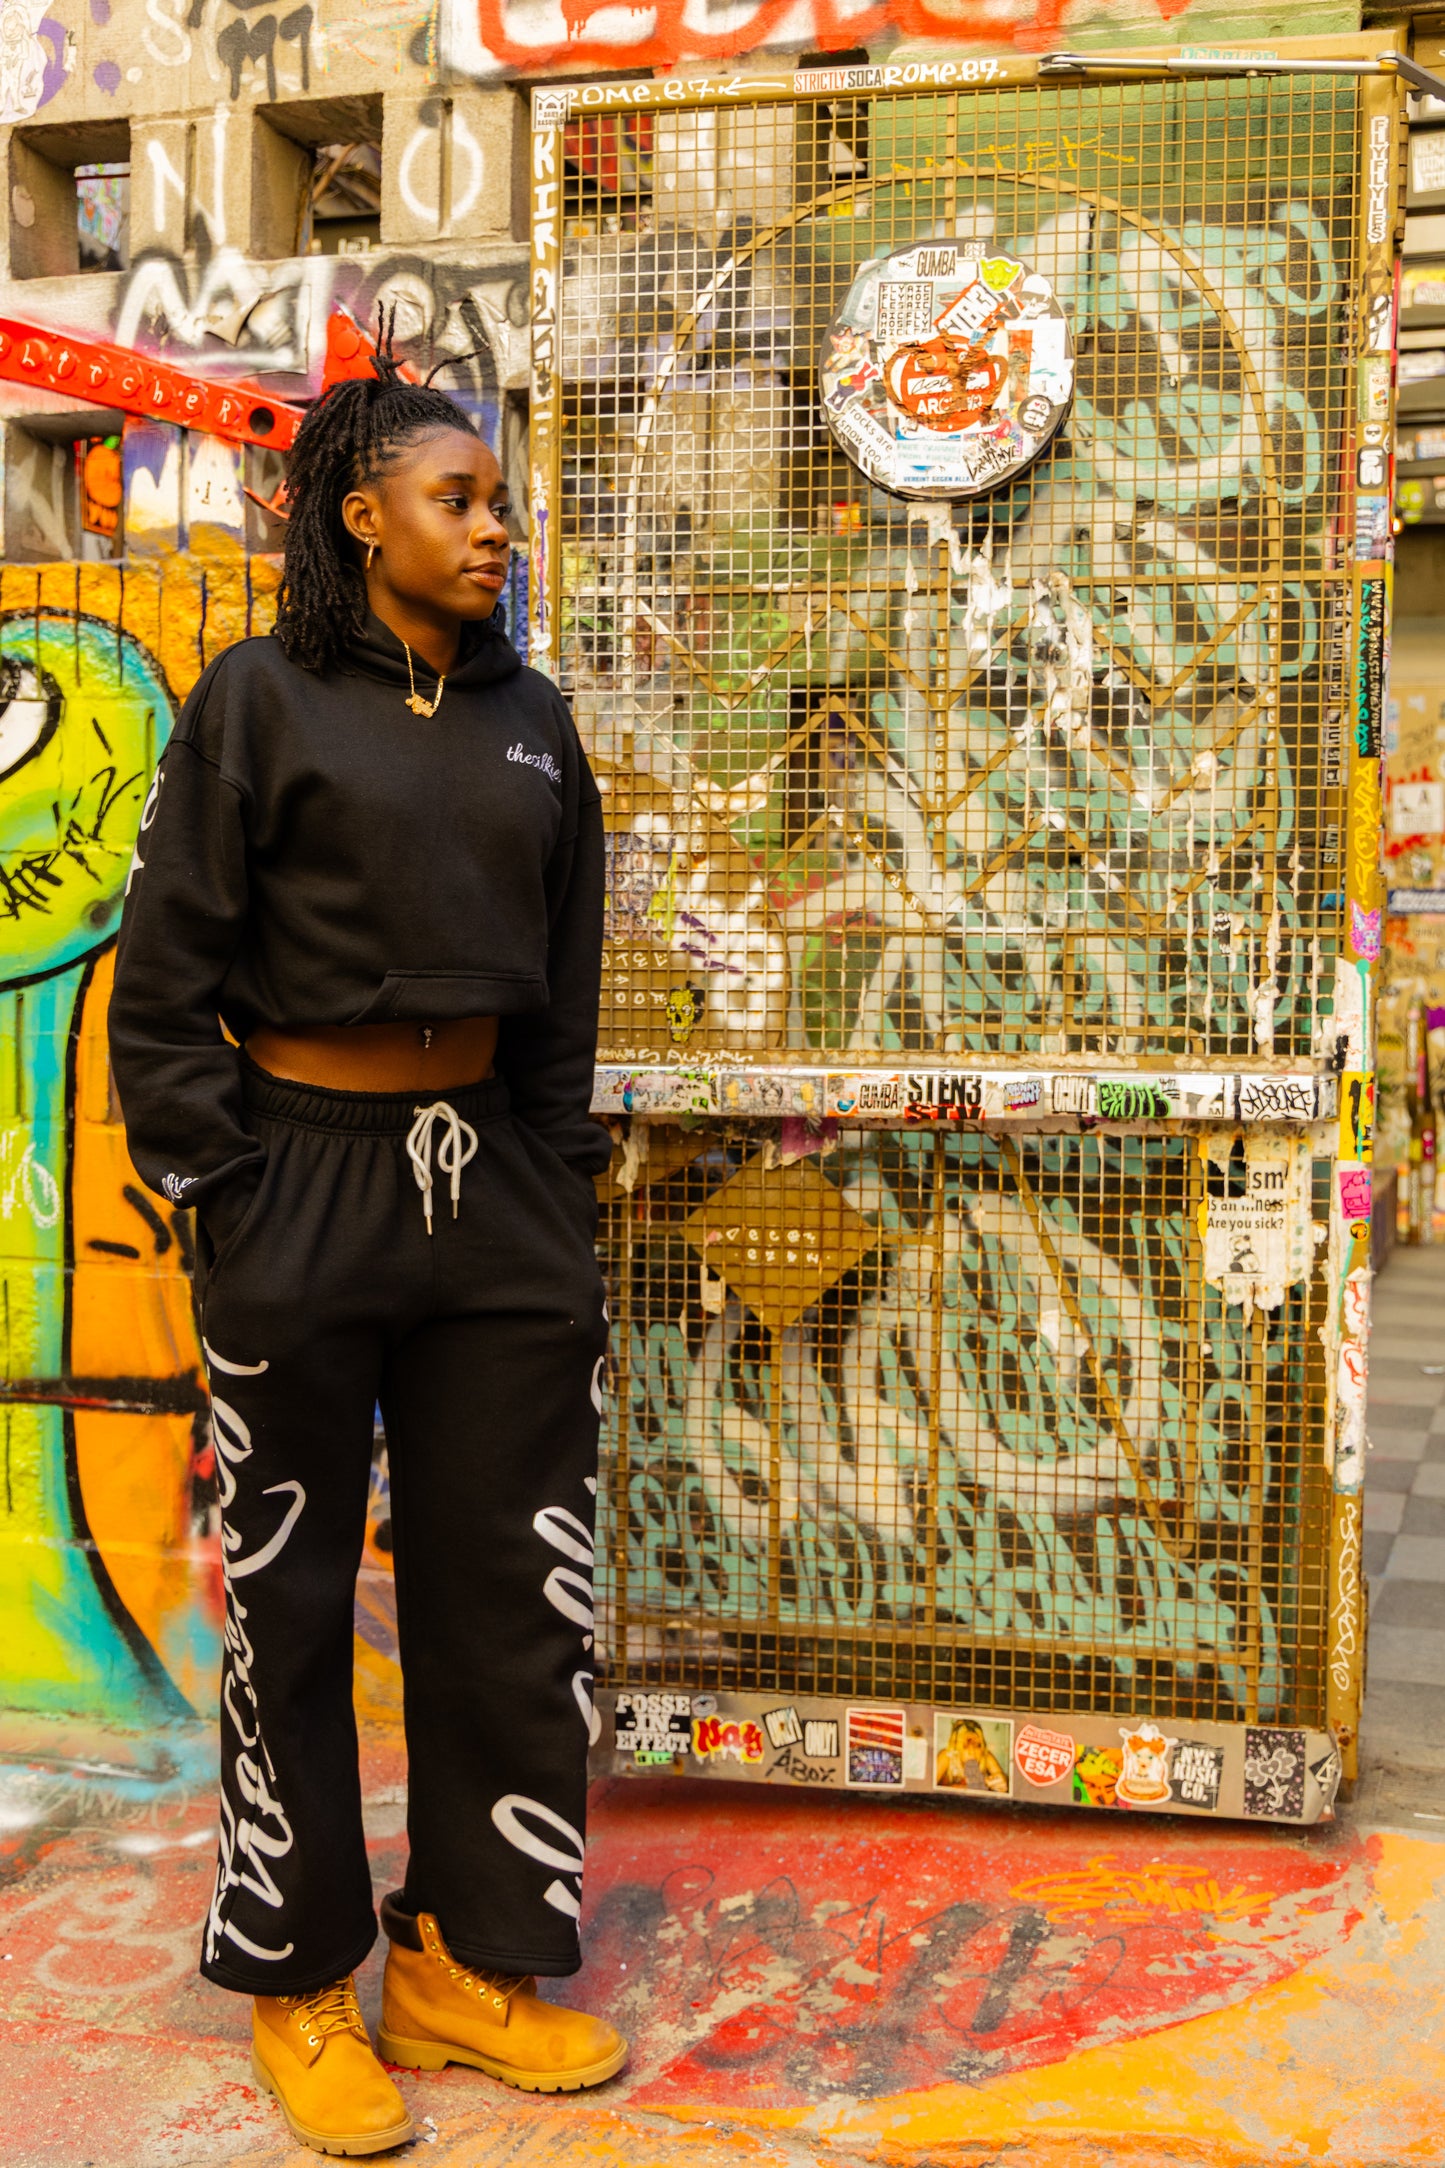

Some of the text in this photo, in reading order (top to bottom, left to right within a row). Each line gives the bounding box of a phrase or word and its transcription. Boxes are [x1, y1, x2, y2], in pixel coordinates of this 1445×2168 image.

[916, 249, 957, 278] GUMBA
[839, 420, 866, 446] snow
[864, 443, 882, 464] too
[850, 408, 894, 452] rocks are
[859, 1082, 899, 1110] GUMBA
[1208, 1217, 1284, 1232] Are you sick?
[615, 1693, 691, 1716] POSSE
[615, 1730, 691, 1754] EFFECT
[1018, 1740, 1071, 1768] ZECER
[1025, 1757, 1057, 1780] ESA
[1180, 1746, 1216, 1769] NYC
[1181, 1780, 1209, 1802] CO.
